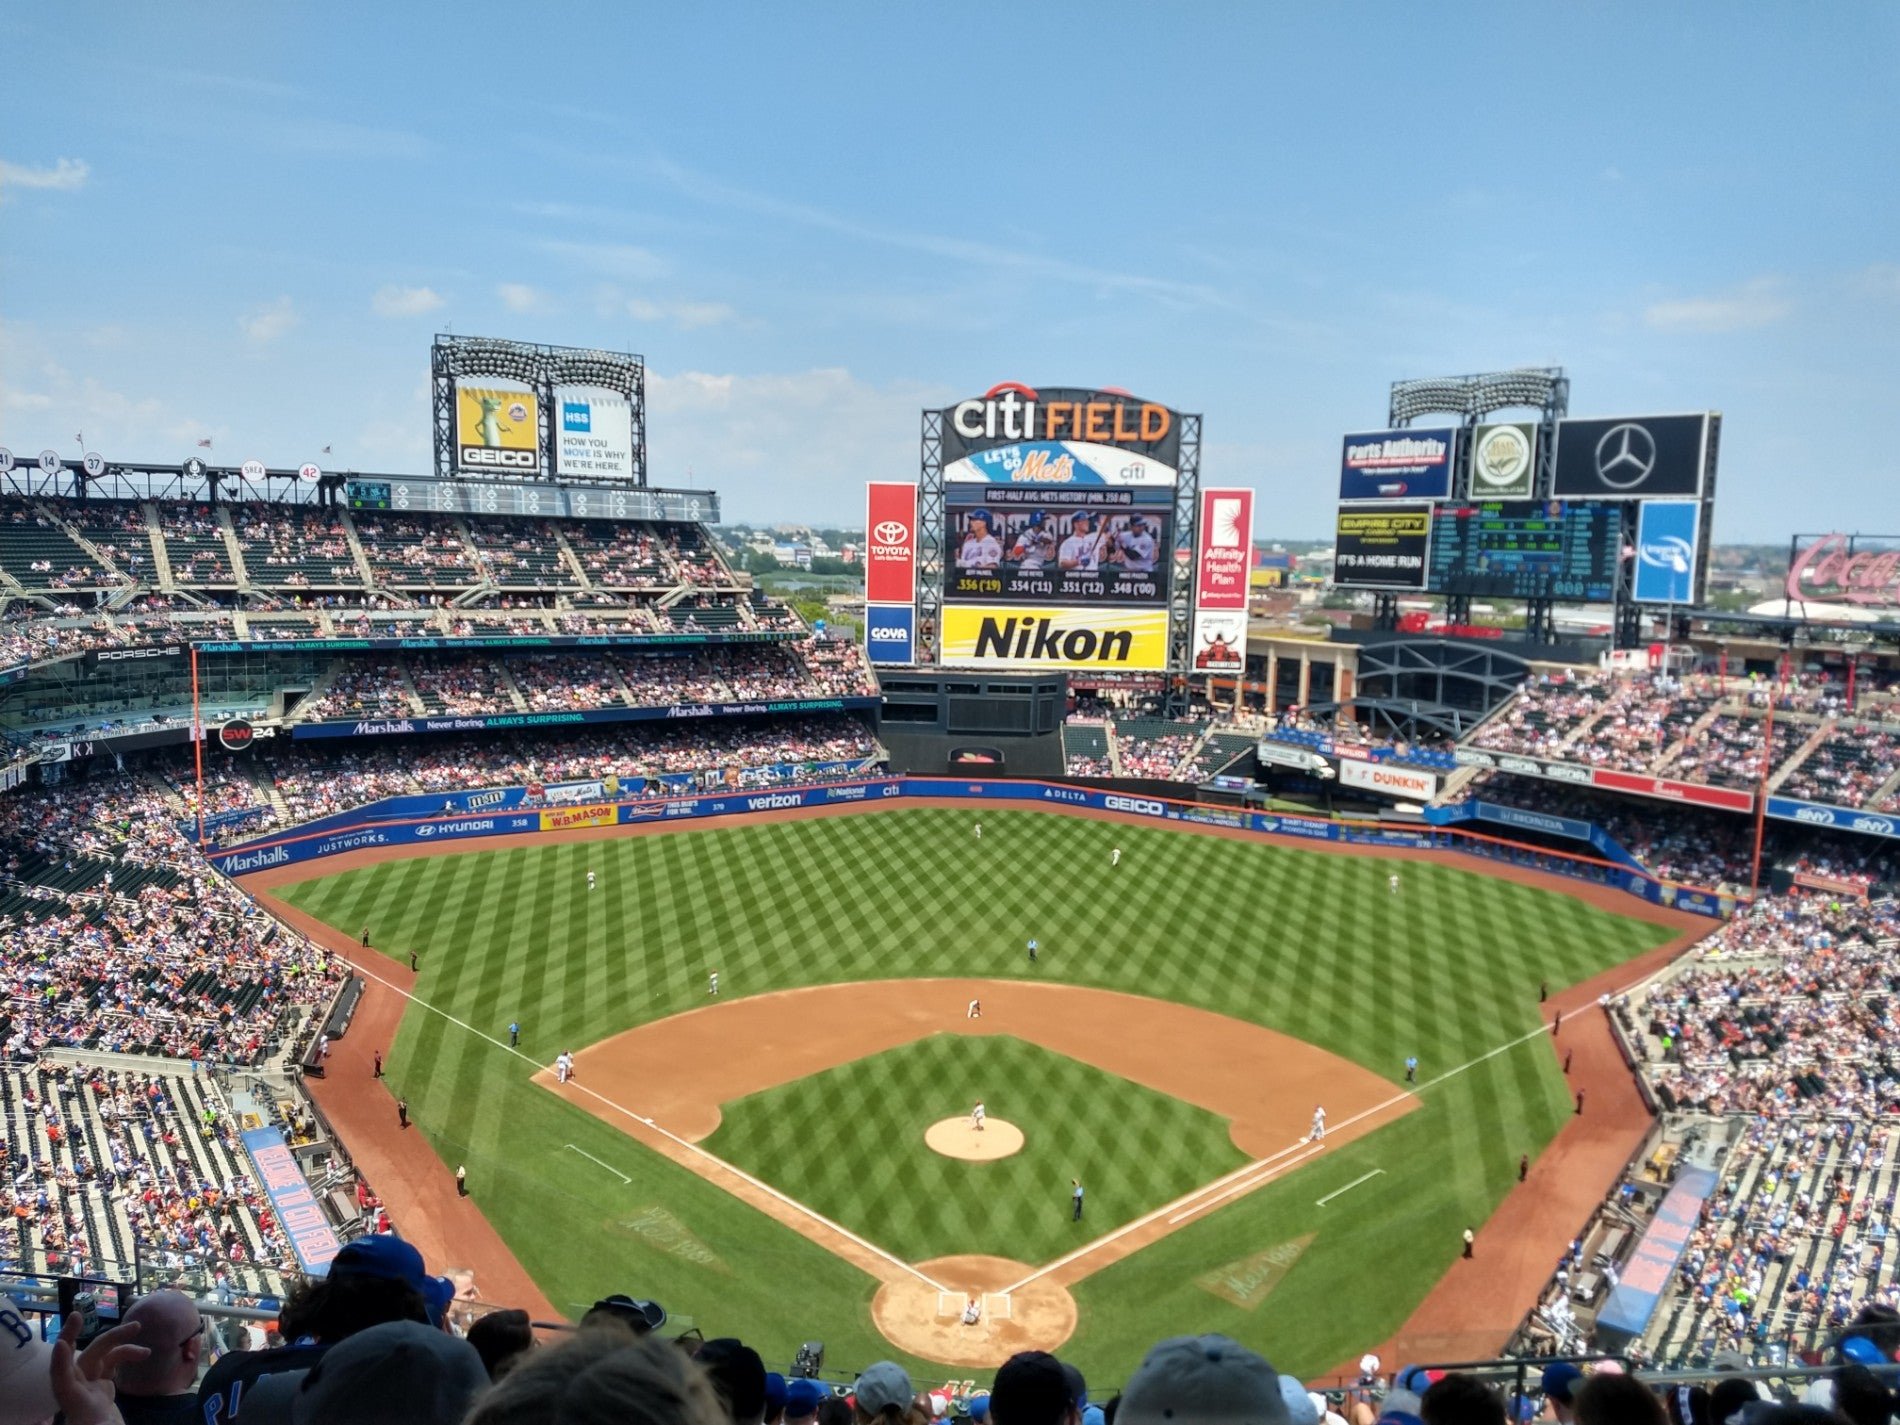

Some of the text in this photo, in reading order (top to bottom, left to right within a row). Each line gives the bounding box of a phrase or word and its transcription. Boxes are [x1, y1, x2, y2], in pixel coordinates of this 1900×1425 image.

[565, 412, 589, 423] HSS
[954, 391, 1171, 440] citi FIELD
[563, 437, 608, 448] HOW YOU
[1347, 437, 1447, 460] Parts Authority
[463, 448, 535, 466] GEICO
[564, 448, 625, 460] MOVE IS WHY
[984, 447, 1021, 464] LET'S
[44, 456, 55, 467] 14
[87, 458, 100, 469] 37
[563, 459, 622, 471] WE'RE HERE.
[1004, 459, 1022, 470] GO
[1012, 450, 1075, 483] Mets
[244, 466, 262, 475] SHEA
[303, 468, 317, 477] 42
[1120, 462, 1145, 479] citi
[1342, 519, 1422, 528] EMPIRE CITY
[871, 546, 911, 556] TOYOTA
[1204, 548, 1245, 563] Affinity
[1206, 561, 1241, 573] Health
[1337, 554, 1422, 568] IT'S A HOME RUN
[1212, 573, 1235, 585] Plan
[957, 579, 1001, 593] .356 ('19)
[1008, 580, 1053, 594] .354 ('11)
[1059, 582, 1105, 595] .351 ('12)
[1110, 583, 1131, 594] .348
[871, 628, 908, 639] GOYA
[975, 617, 1132, 661] Nikon
[200, 643, 242, 652] Marshalls
[400, 639, 438, 647] Marshalls
[98, 647, 181, 661] PORSCHE
[666, 705, 714, 718] Marshalls
[744, 704, 768, 713] Boring.
[768, 702, 798, 711] ALWAYS
[799, 700, 843, 710] SURPRISING.
[353, 713, 584, 735] Marshalls Never Boring. ALWAYS SURPRISING.
[73, 743, 82, 757] K
[1373, 772, 1429, 790] DUNKIN'
[835, 787, 866, 796] National
[883, 785, 899, 796] citi
[1054, 789, 1086, 801] DELTA
[748, 793, 800, 810] verizon
[1105, 795, 1164, 815] GEICO
[1514, 813, 1564, 831] HONDA
[1796, 809, 1828, 824] SNY
[439, 820, 494, 833] HYUNDAI
[511, 819, 528, 828] 358
[1853, 818, 1886, 833] SNY
[317, 834, 389, 854] JUSTWORKS.
[222, 846, 289, 873] Marshalls
